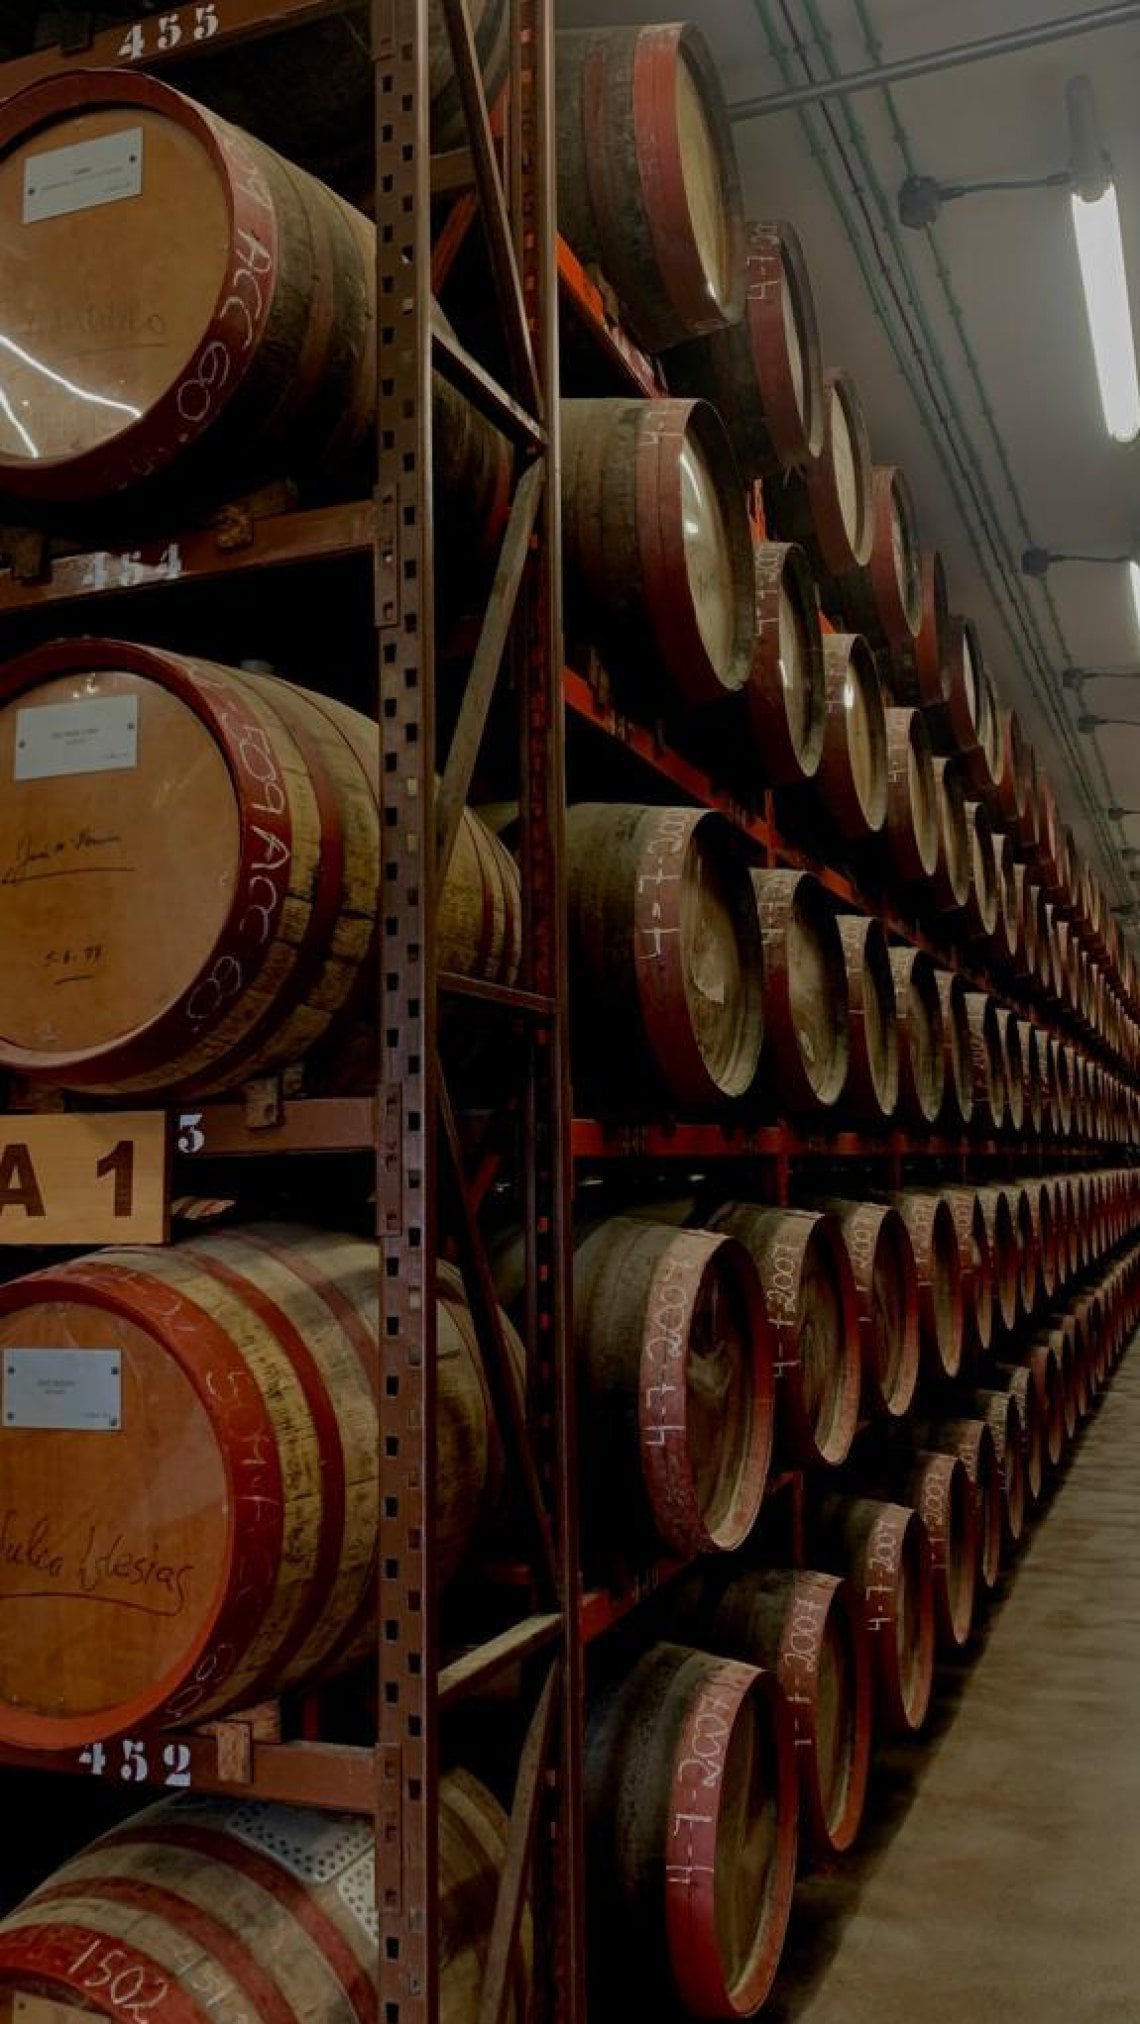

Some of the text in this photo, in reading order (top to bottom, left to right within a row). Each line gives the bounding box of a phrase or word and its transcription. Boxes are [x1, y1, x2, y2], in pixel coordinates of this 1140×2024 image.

[118, 3, 219, 61] 455
[0, 1140, 134, 1217] A 1
[78, 1739, 191, 1787] 452
[665, 1692, 730, 1885] 4-7-2007
